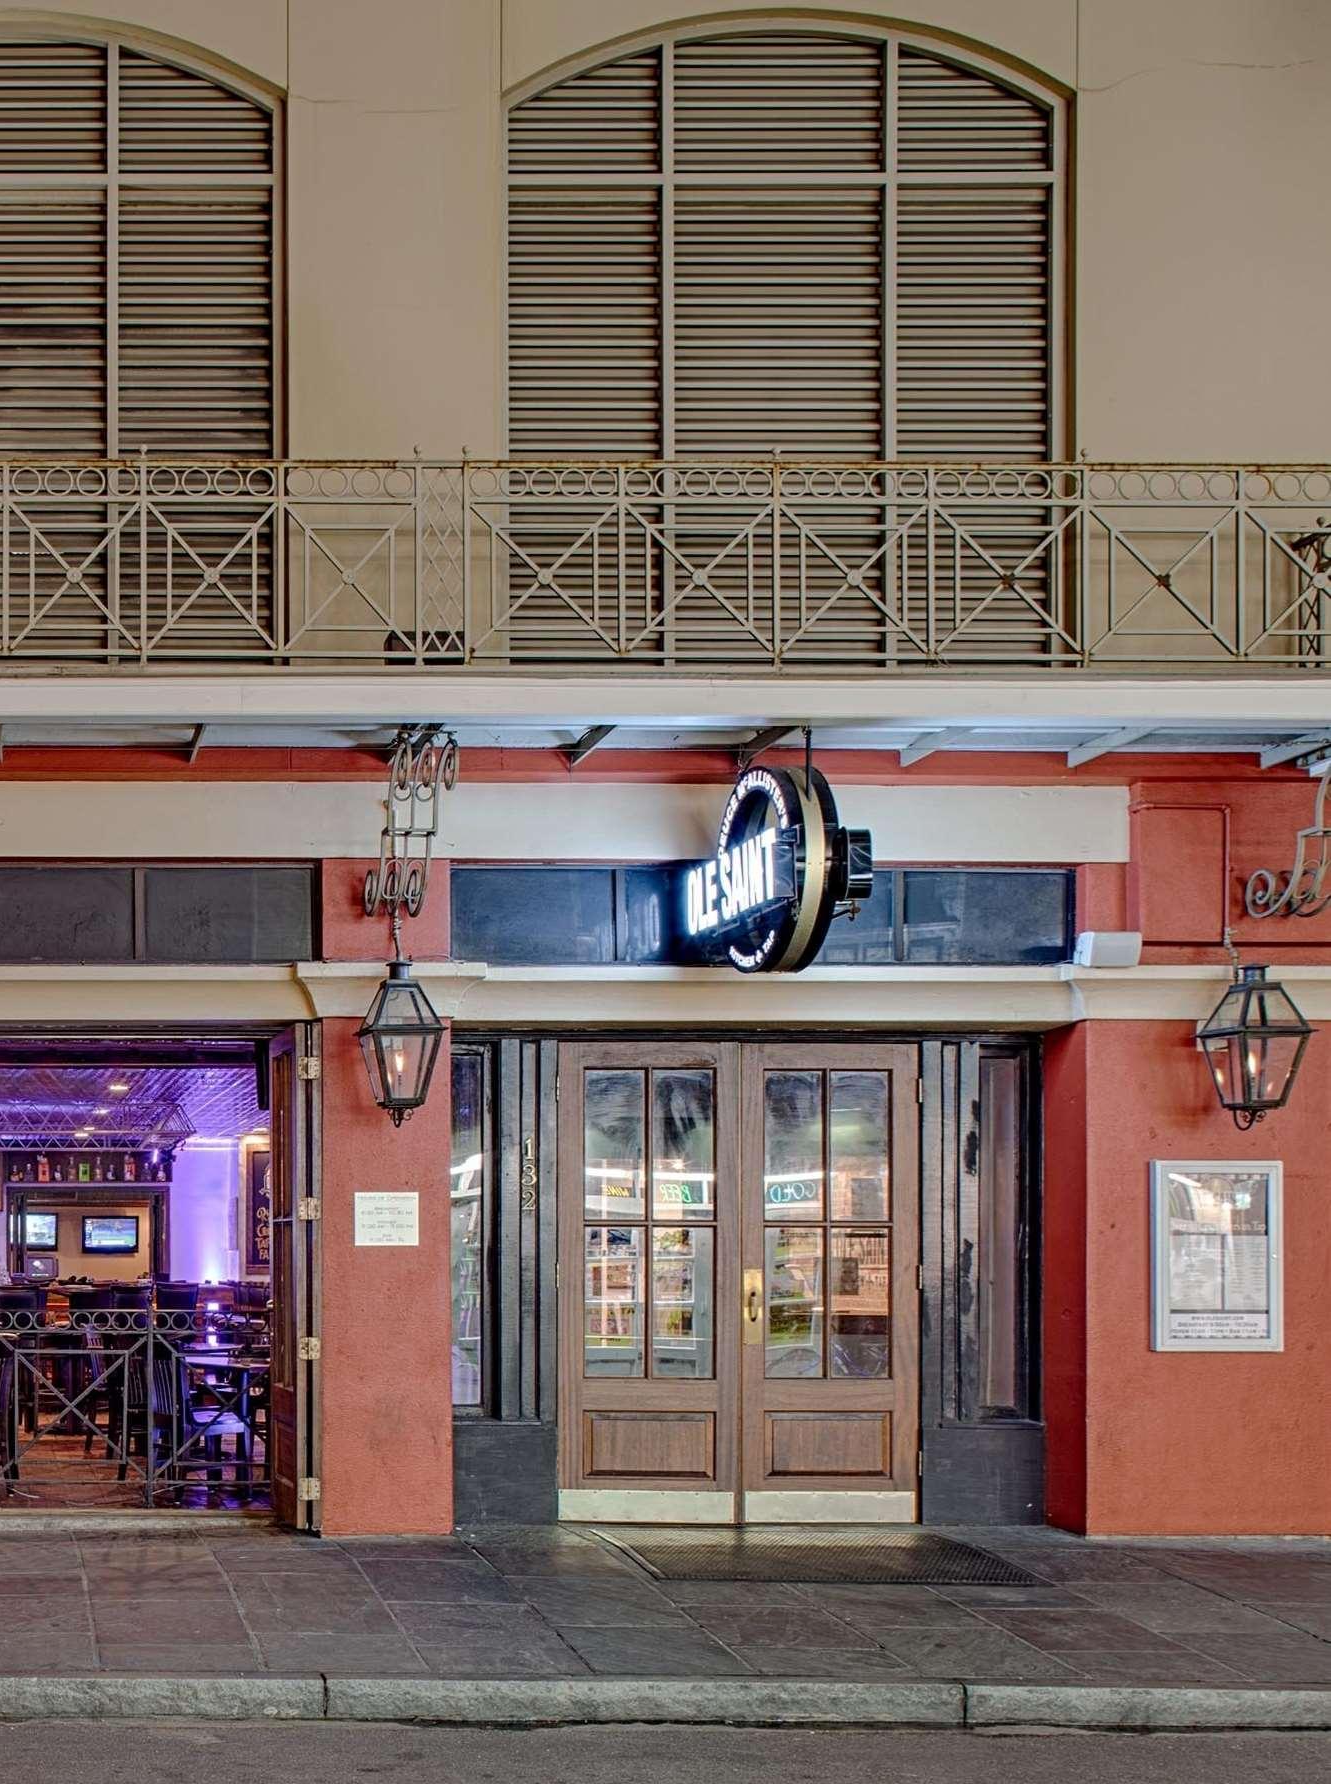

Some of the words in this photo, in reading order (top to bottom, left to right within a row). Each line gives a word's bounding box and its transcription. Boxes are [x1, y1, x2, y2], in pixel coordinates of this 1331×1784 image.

[686, 859, 719, 936] OLE
[719, 827, 777, 921] SAINT
[729, 945, 756, 968] KITCHEN
[762, 929, 775, 954] TAP
[522, 1138, 537, 1210] 132
